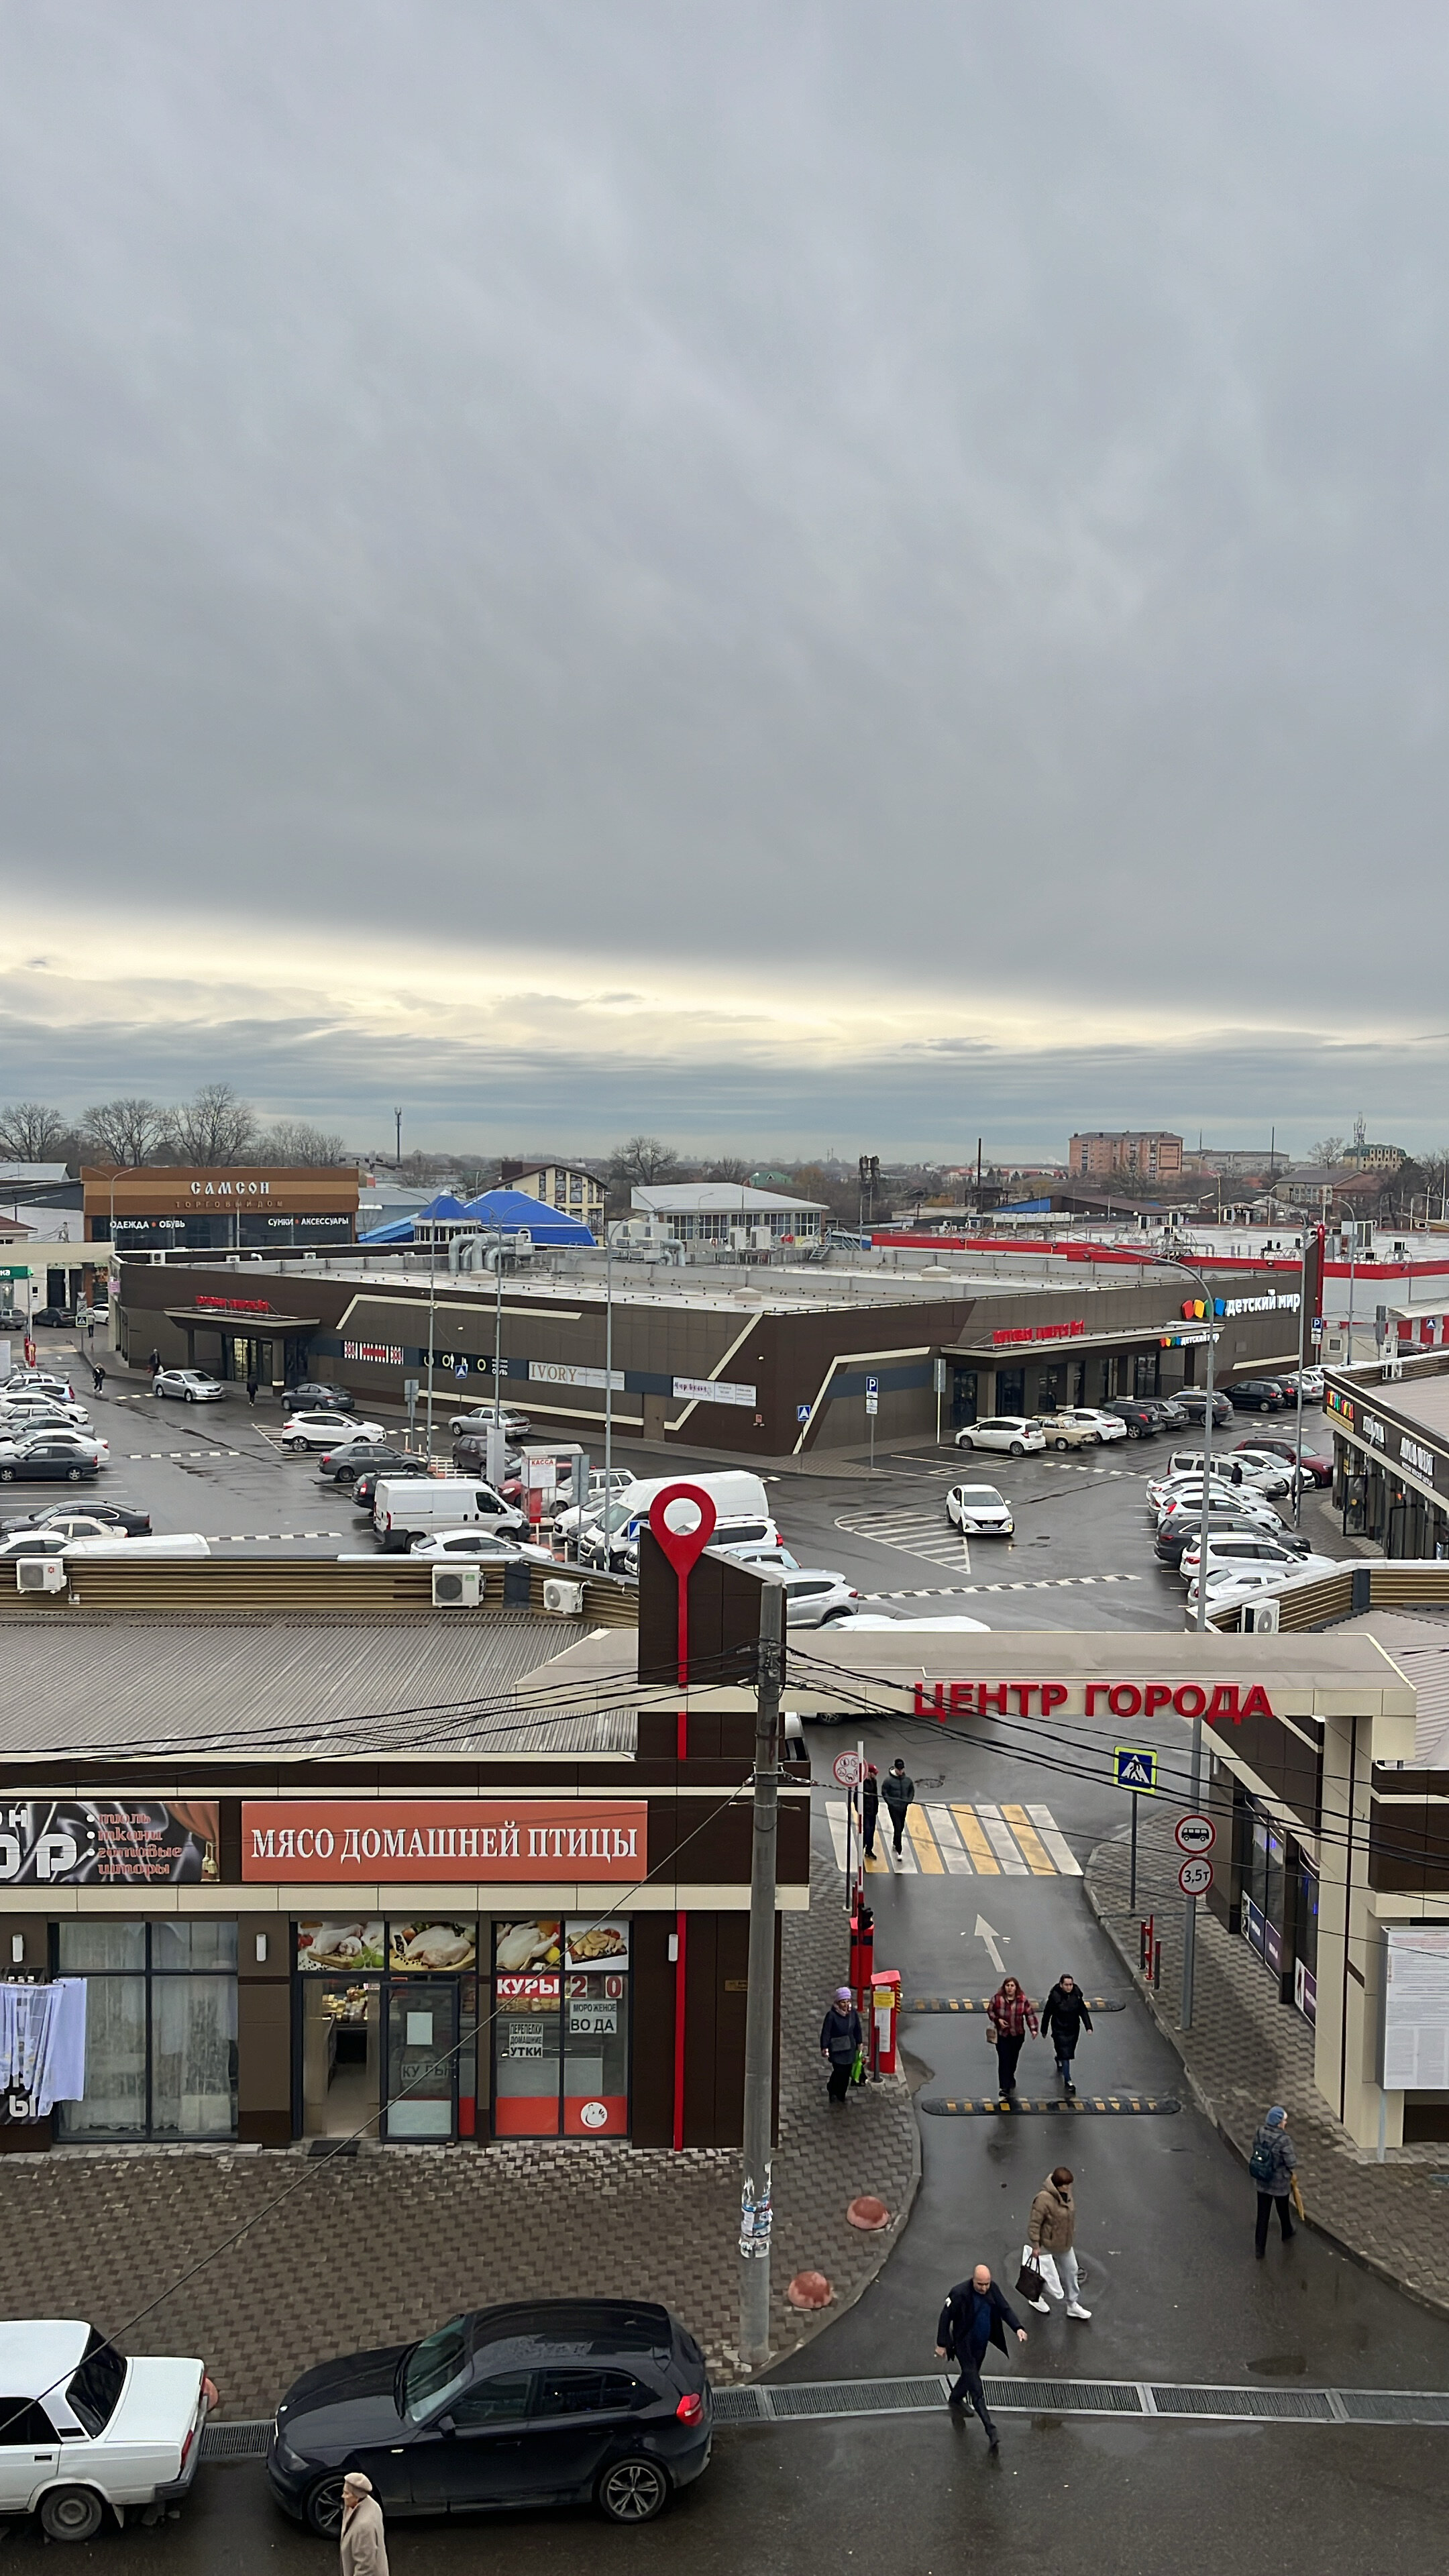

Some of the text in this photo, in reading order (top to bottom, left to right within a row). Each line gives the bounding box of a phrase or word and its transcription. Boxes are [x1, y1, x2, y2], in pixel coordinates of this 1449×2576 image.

[191, 1181, 270, 1195] САМСОН
[258, 1200, 283, 1208] ДОМ
[110, 1220, 185, 1229] ОДЕЖДА ОБУВЬ
[268, 1217, 349, 1226] СУМКИ АКСЕССУАРЫ
[1226, 1288, 1301, 1317] детский мир
[531, 1364, 577, 1382] IVORY
[914, 1682, 1273, 1725] ЦЕНТР ГОРОДА
[99, 1813, 151, 1825] тюль
[98, 1827, 162, 1841] ткани
[251, 1820, 637, 1864] МЯСО ДОМАШНЕЙ ПТИЦЫ
[98, 1844, 182, 1858] готовые
[99, 1863, 169, 1877] шторы
[497, 1979, 559, 1994] КУРЫ
[511, 2047, 541, 2056] УТКИ
